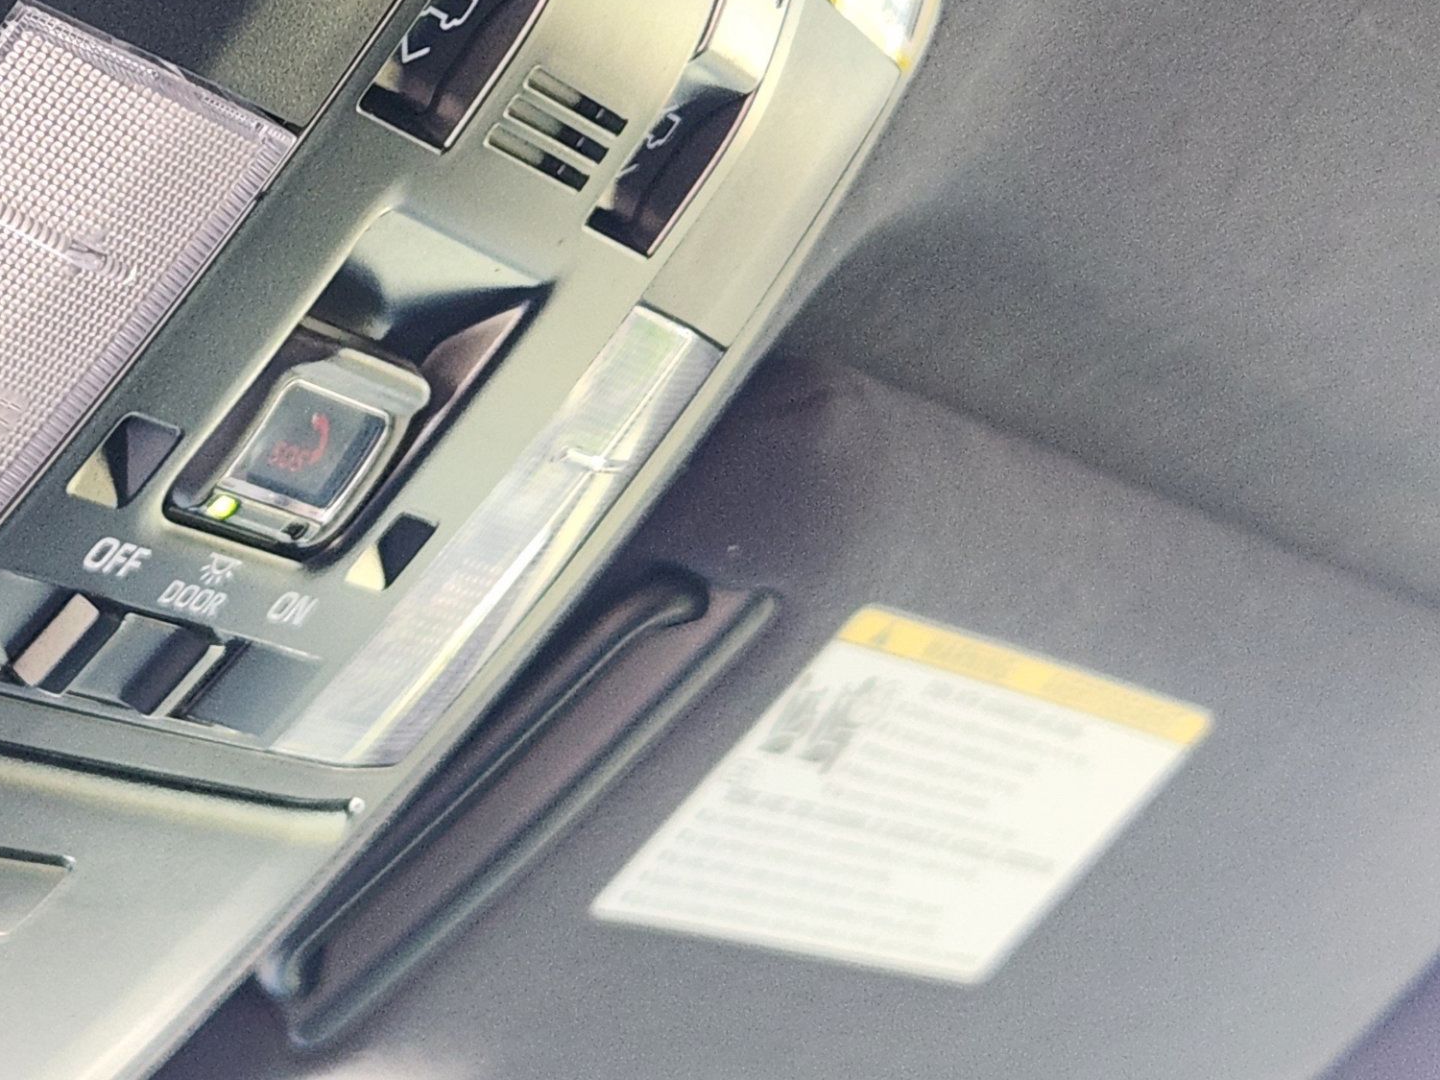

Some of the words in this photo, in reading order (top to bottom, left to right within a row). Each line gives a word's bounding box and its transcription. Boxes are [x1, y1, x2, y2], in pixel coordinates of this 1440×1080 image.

[82, 536, 151, 578] OFF
[157, 579, 229, 617] DOOR
[265, 590, 319, 626] ON
